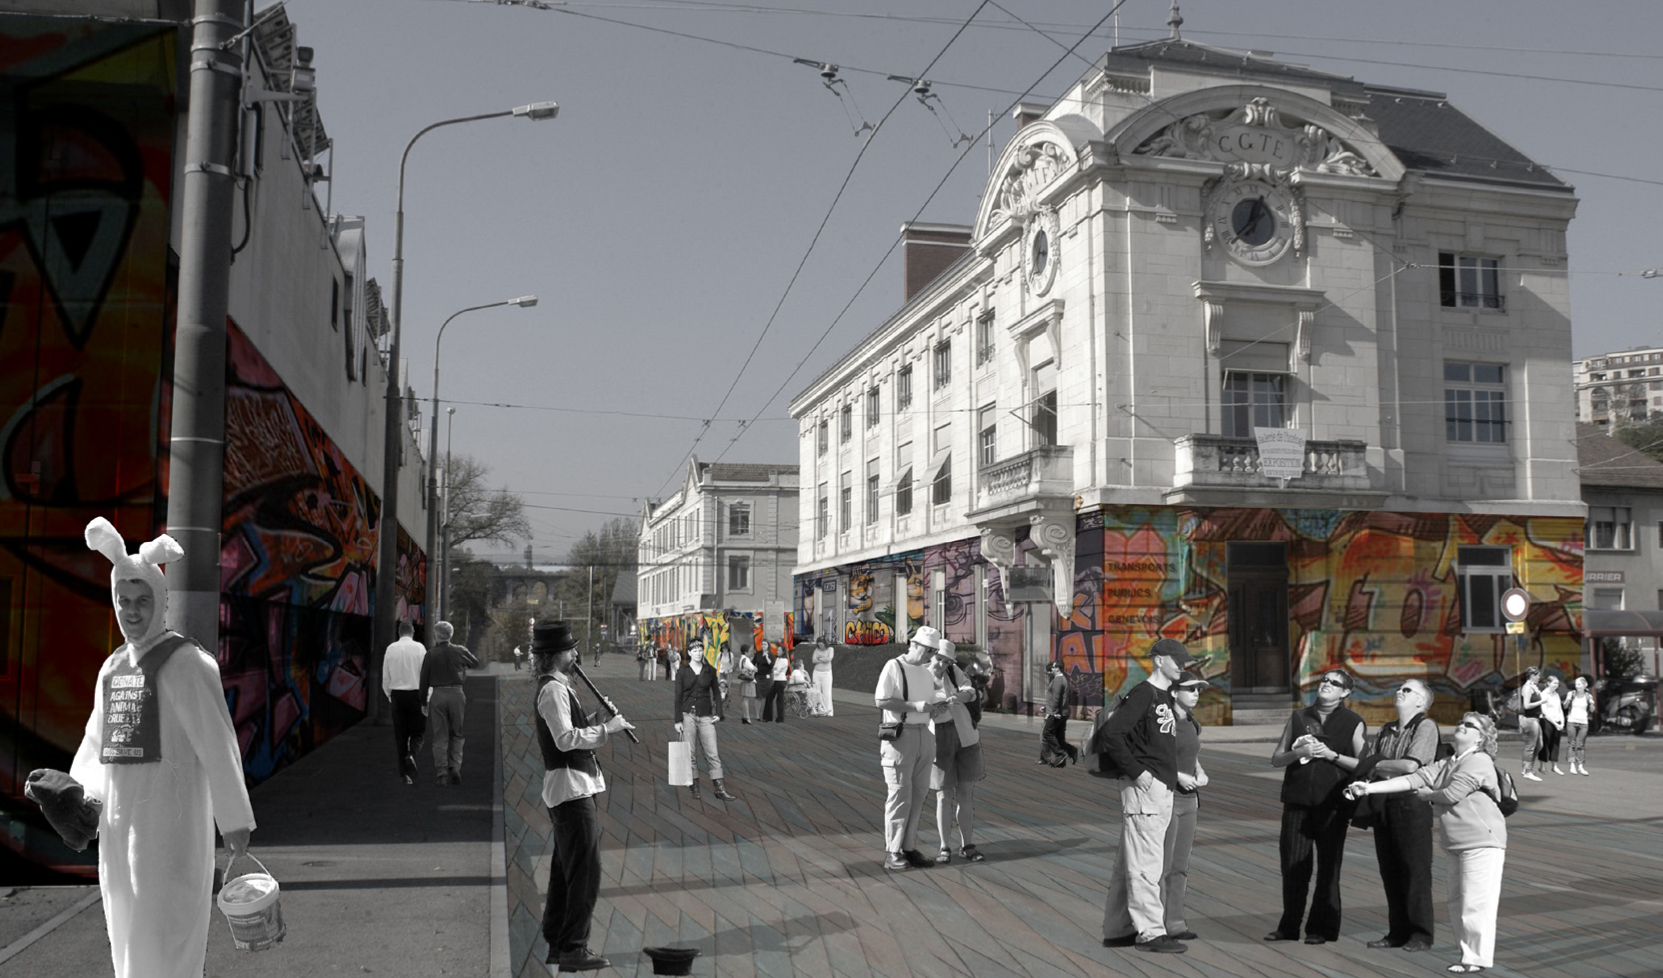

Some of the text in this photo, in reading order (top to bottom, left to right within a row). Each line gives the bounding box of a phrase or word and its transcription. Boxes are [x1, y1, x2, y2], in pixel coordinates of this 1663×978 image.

[1218, 132, 1284, 160] CGTE
[1108, 562, 1176, 573] TRANSPORTS
[1108, 588, 1152, 598] PUBLICS
[1108, 614, 1160, 624] GENEVOIS
[113, 676, 144, 687] DONATE
[110, 690, 143, 701] AGAINST
[134, 748, 142, 756] US
